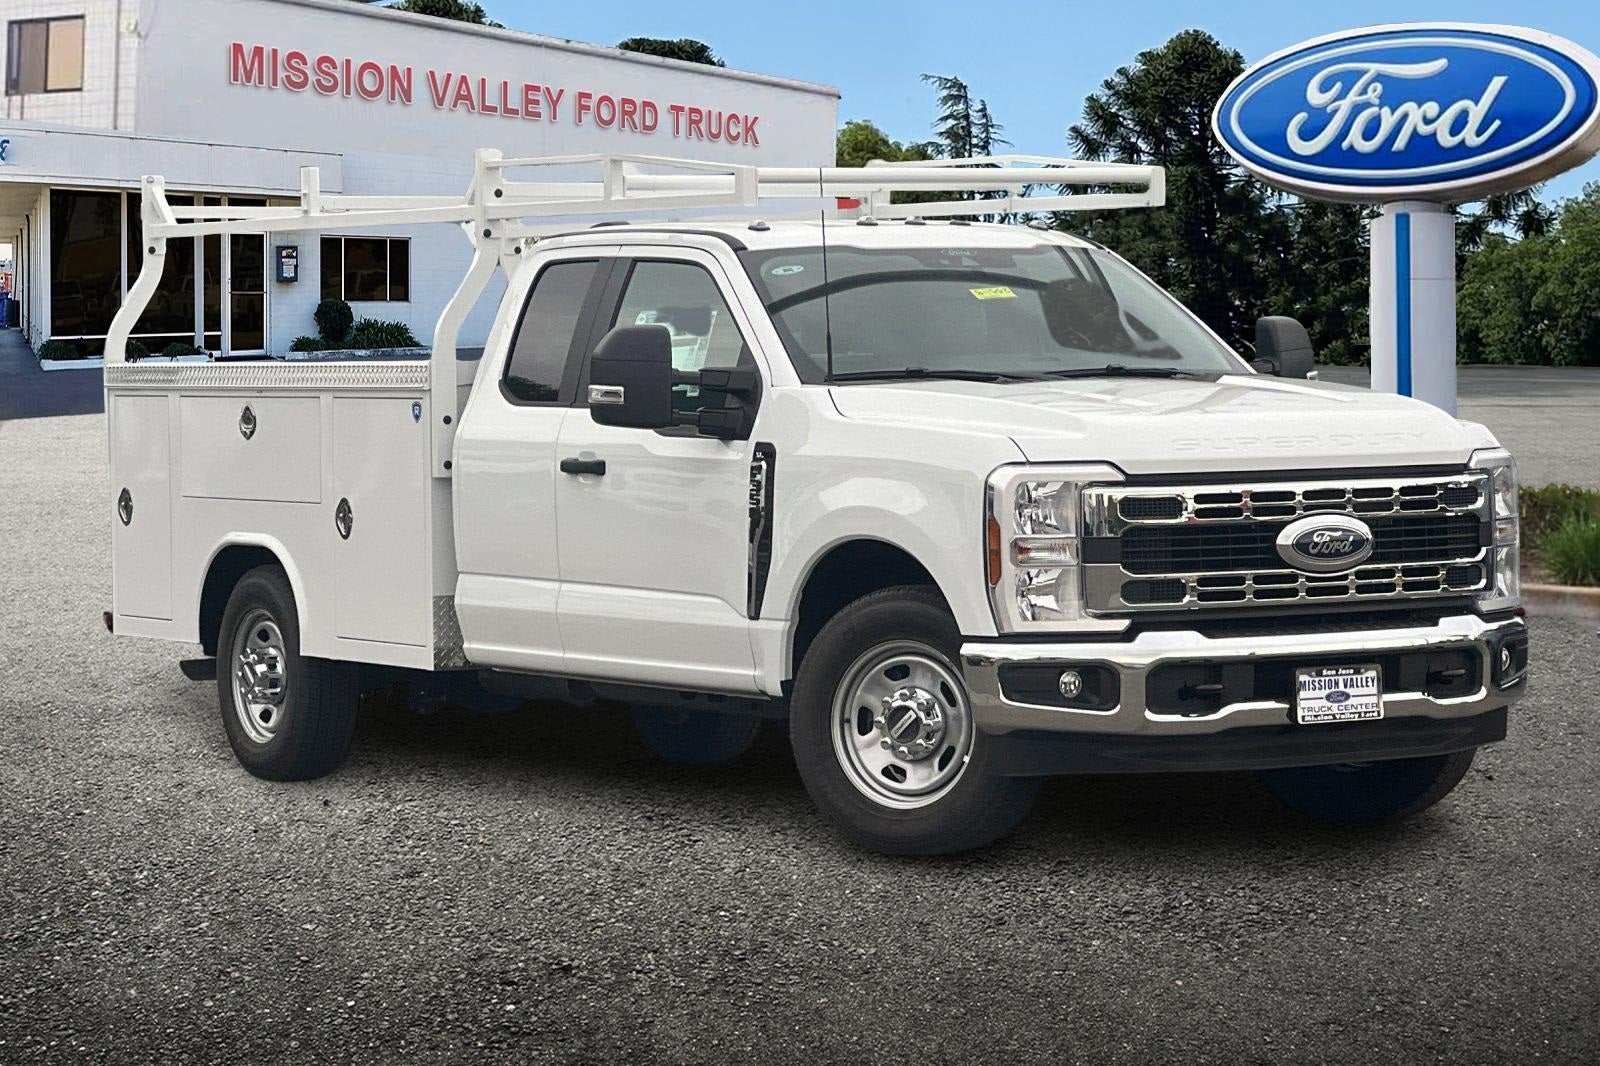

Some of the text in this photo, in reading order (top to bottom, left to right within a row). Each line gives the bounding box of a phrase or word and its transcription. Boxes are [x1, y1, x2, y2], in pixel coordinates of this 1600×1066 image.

[230, 41, 760, 145] MISSION VALLEY FORD TRUCK
[1286, 58, 1508, 156] Ford
[1171, 432, 1426, 451] SUPER DUTY
[1308, 530, 1354, 554] Ford
[1299, 675, 1376, 692] MISSION VALLEY
[1301, 702, 1378, 714] TRUCK CENTER
[1335, 712, 1360, 720] Valley
